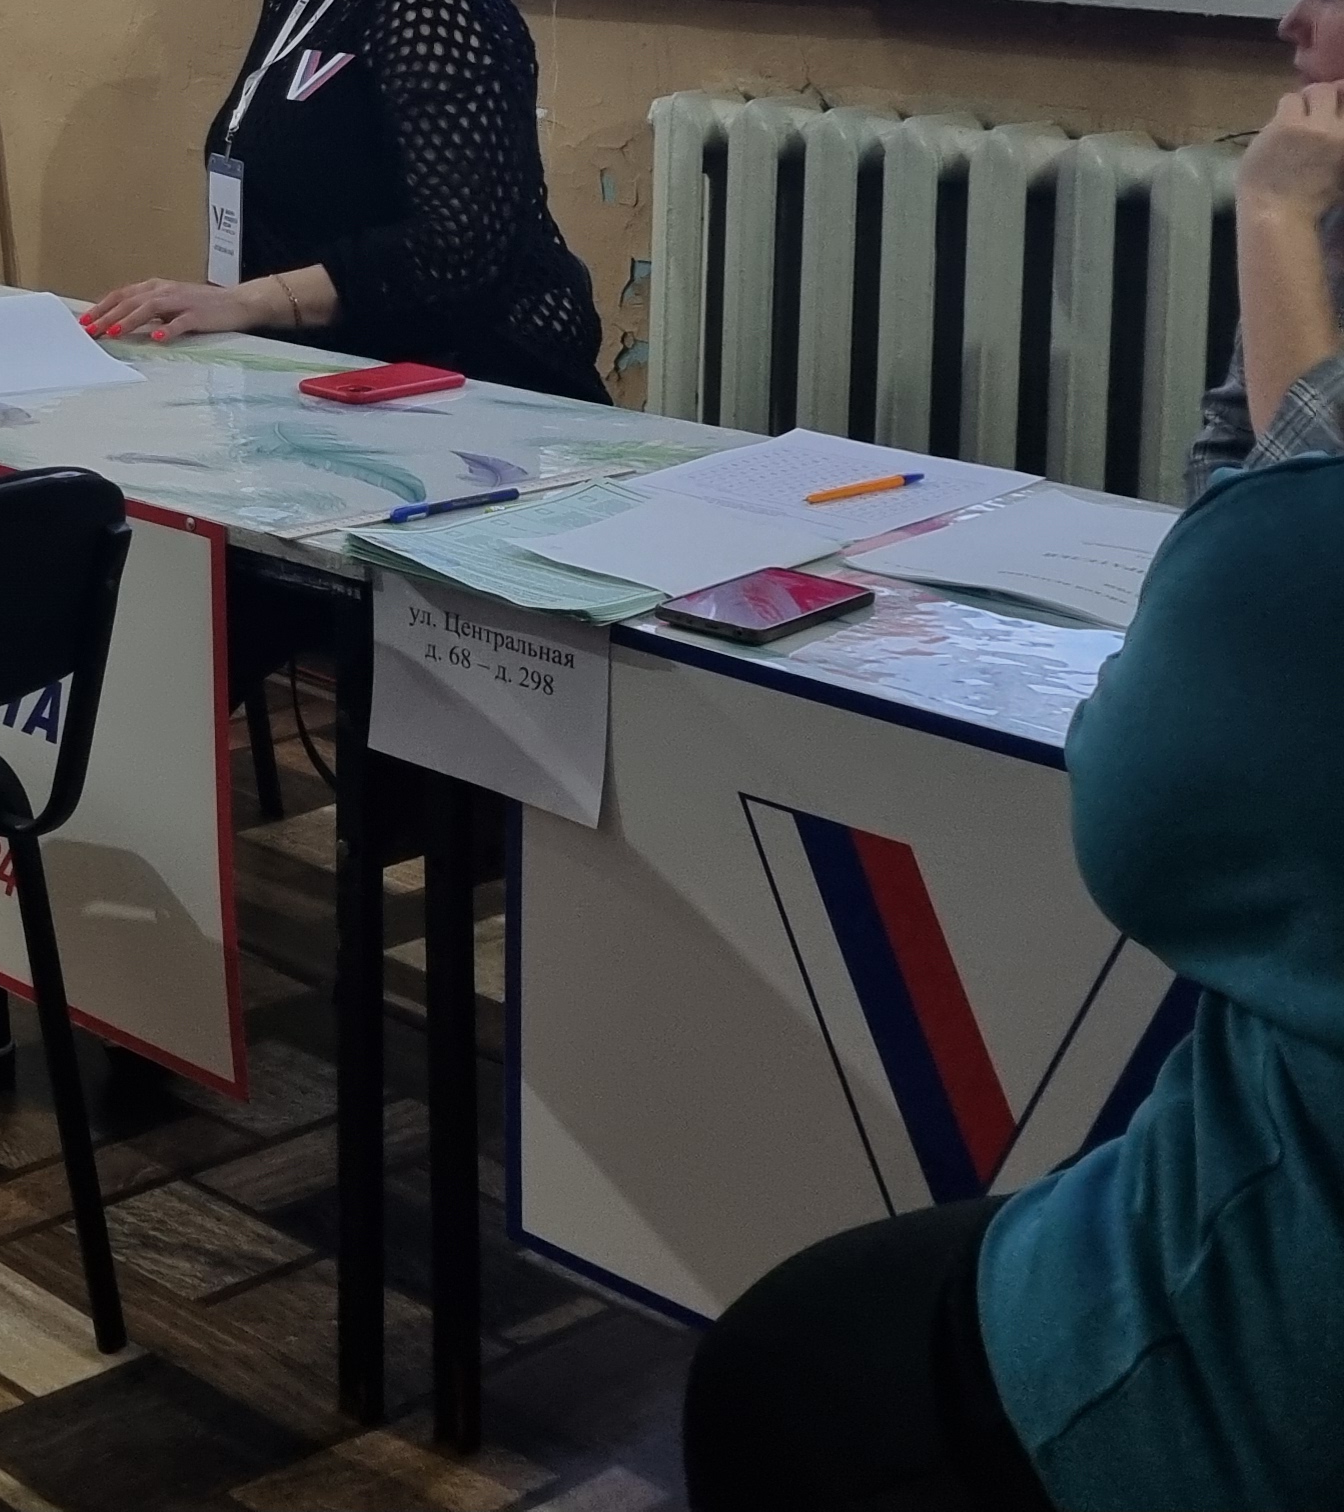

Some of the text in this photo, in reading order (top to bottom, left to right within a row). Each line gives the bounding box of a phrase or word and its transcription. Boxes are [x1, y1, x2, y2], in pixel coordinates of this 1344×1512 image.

[409, 606, 576, 670] ул. Центральная
[424, 643, 442, 662] д.
[449, 645, 472, 670] 68
[494, 664, 512, 683] д.
[518, 666, 555, 696] 298
